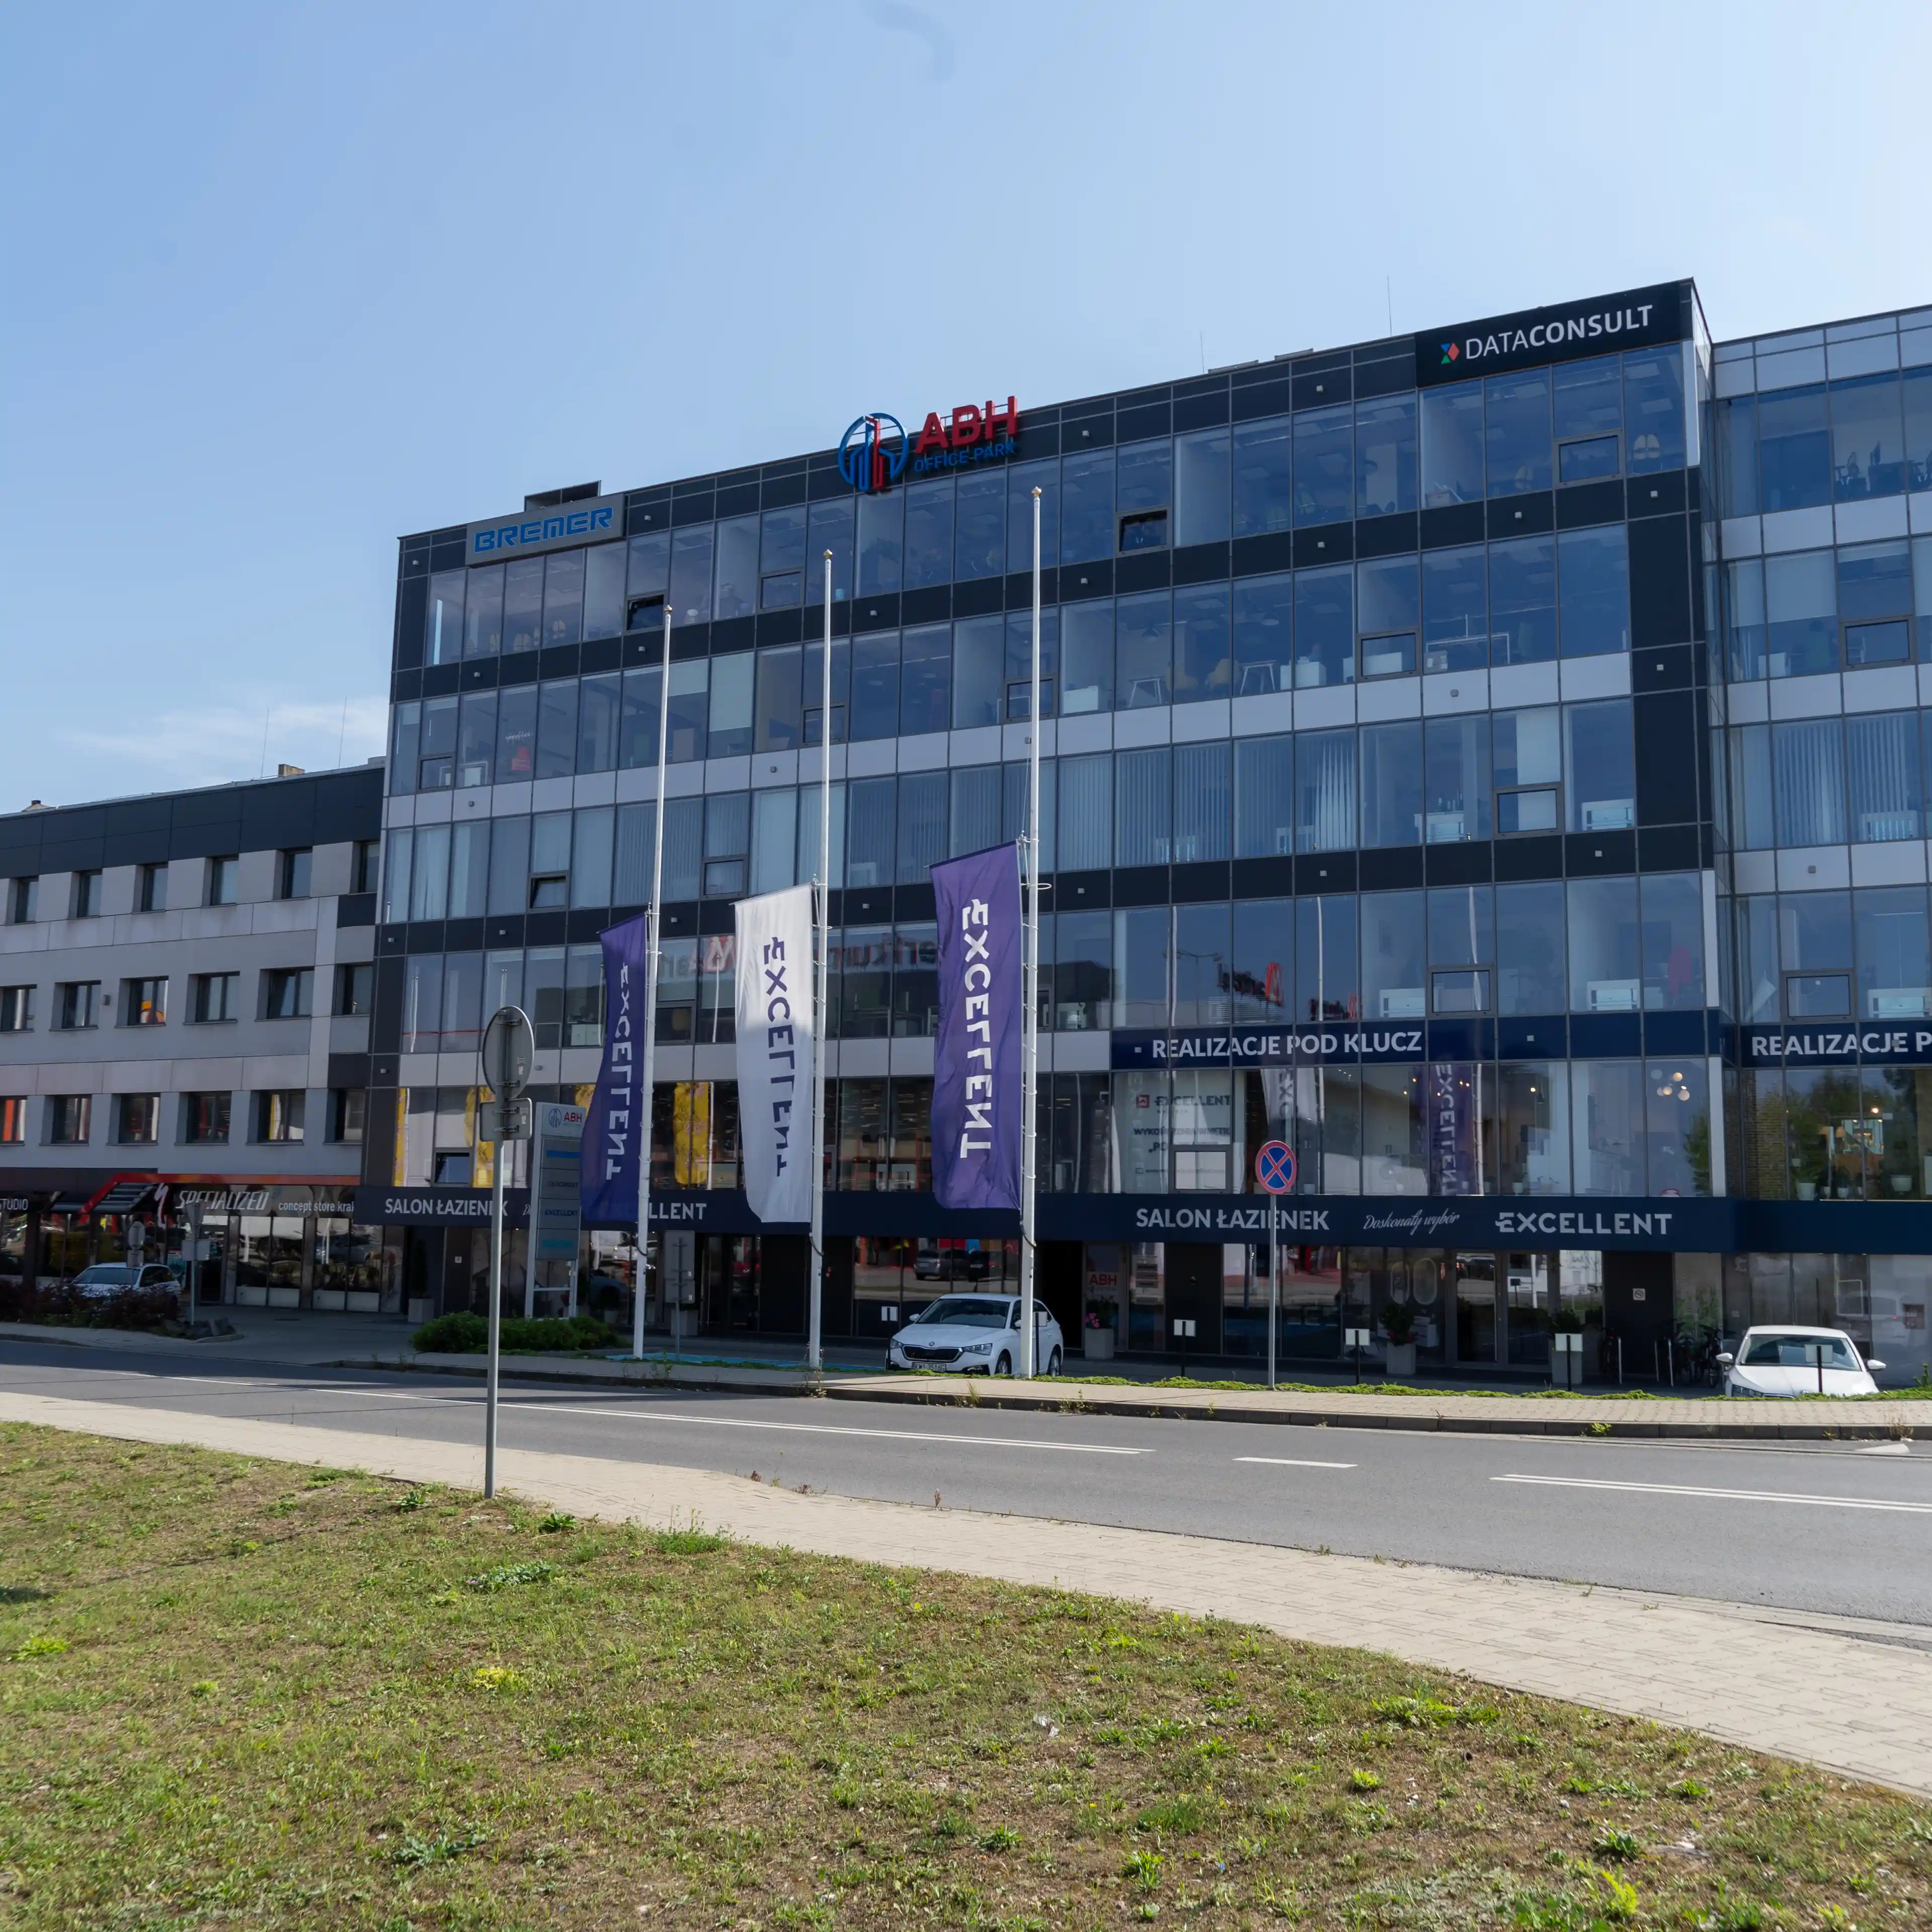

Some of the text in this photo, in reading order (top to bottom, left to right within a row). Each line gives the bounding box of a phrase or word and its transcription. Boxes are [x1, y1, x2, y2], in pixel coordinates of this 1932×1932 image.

[1466, 304, 1653, 360] DATACONSULT
[915, 395, 1018, 454] ABH
[914, 441, 1017, 473] OFFICE PARK
[473, 506, 614, 553] BREMER
[1153, 1031, 1422, 1059] REALIZACJE POD KLUCZ
[1751, 1032, 1909, 1056] REALIZACJE
[564, 1111, 583, 1123] ABH
[278, 1201, 312, 1214] concept
[313, 1202, 336, 1212] store
[384, 1198, 434, 1215] SALON
[649, 1202, 707, 1221] LLENT
[1136, 1208, 1212, 1229] SALON
[1216, 1209, 1330, 1231] ŁAZIENEK
[1495, 1212, 1673, 1236] EXCELLENT
